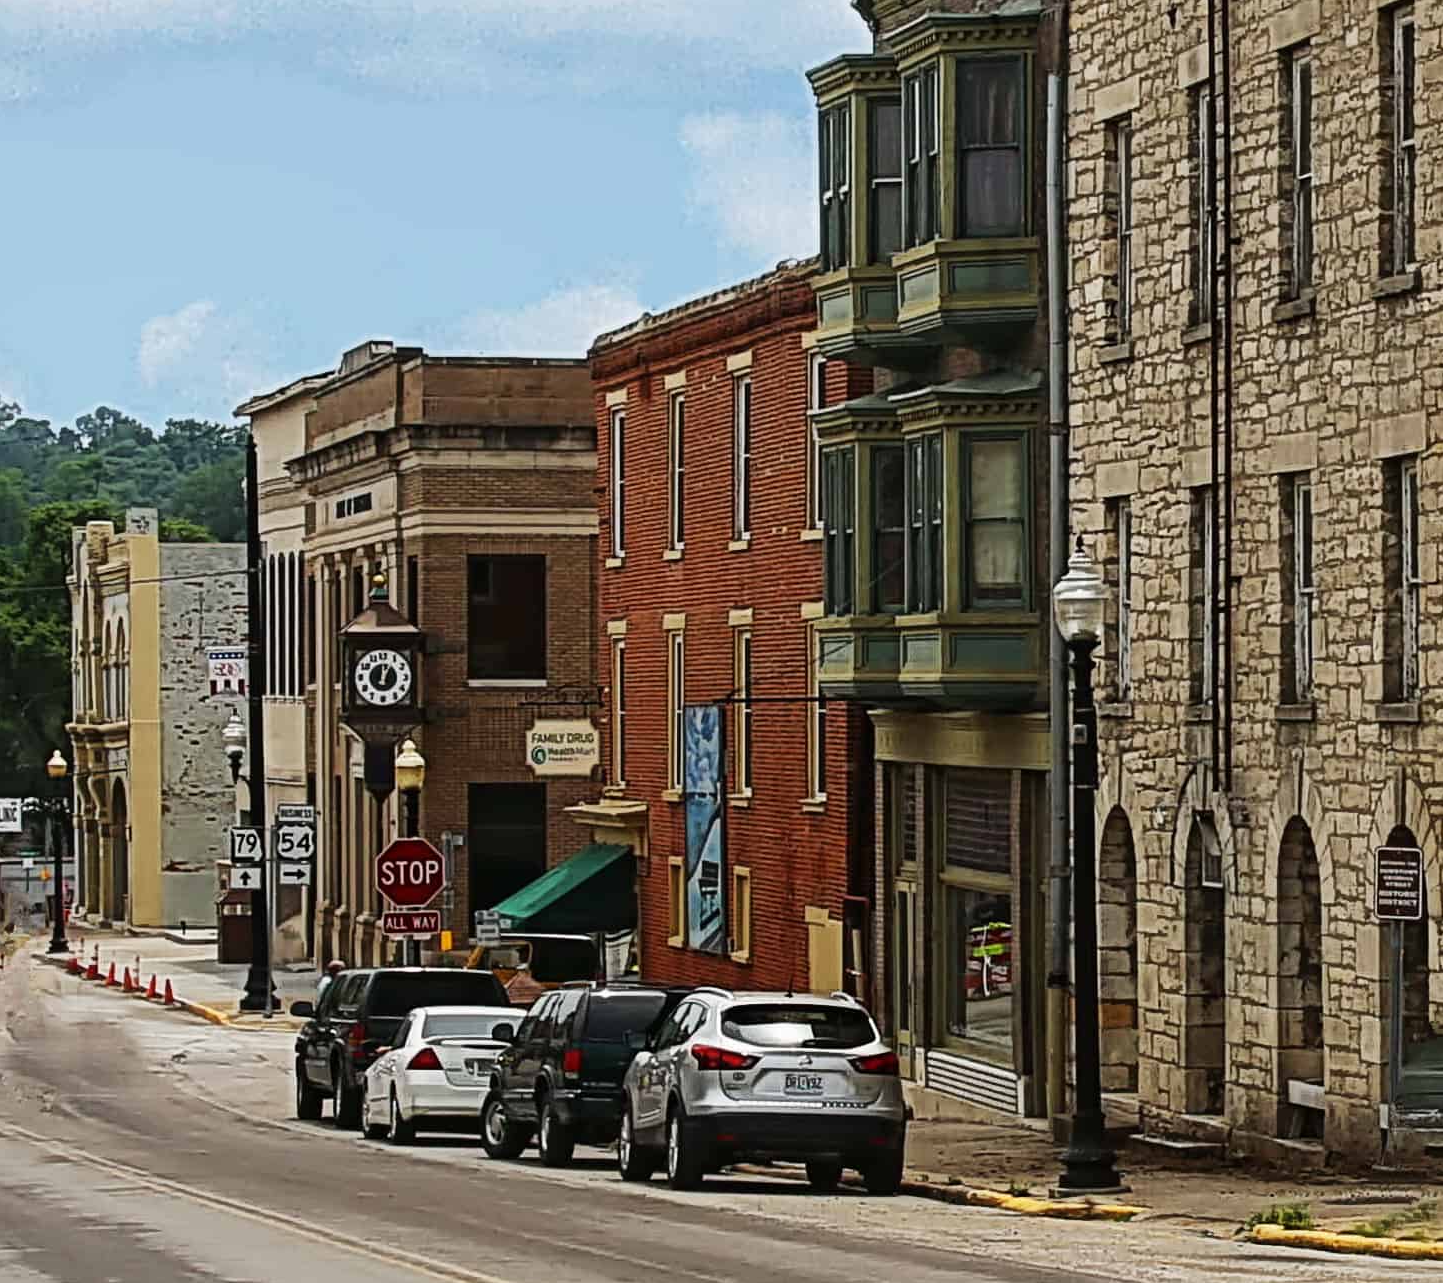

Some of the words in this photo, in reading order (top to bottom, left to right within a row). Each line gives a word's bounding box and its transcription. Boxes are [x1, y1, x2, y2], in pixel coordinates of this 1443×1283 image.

[532, 733, 565, 744] FAMILY
[567, 732, 594, 744] DRUG
[236, 833, 258, 854] 79
[281, 832, 311, 853] 54
[380, 860, 439, 886] STOP
[385, 916, 408, 930] ALL
[412, 916, 437, 929] WAY
